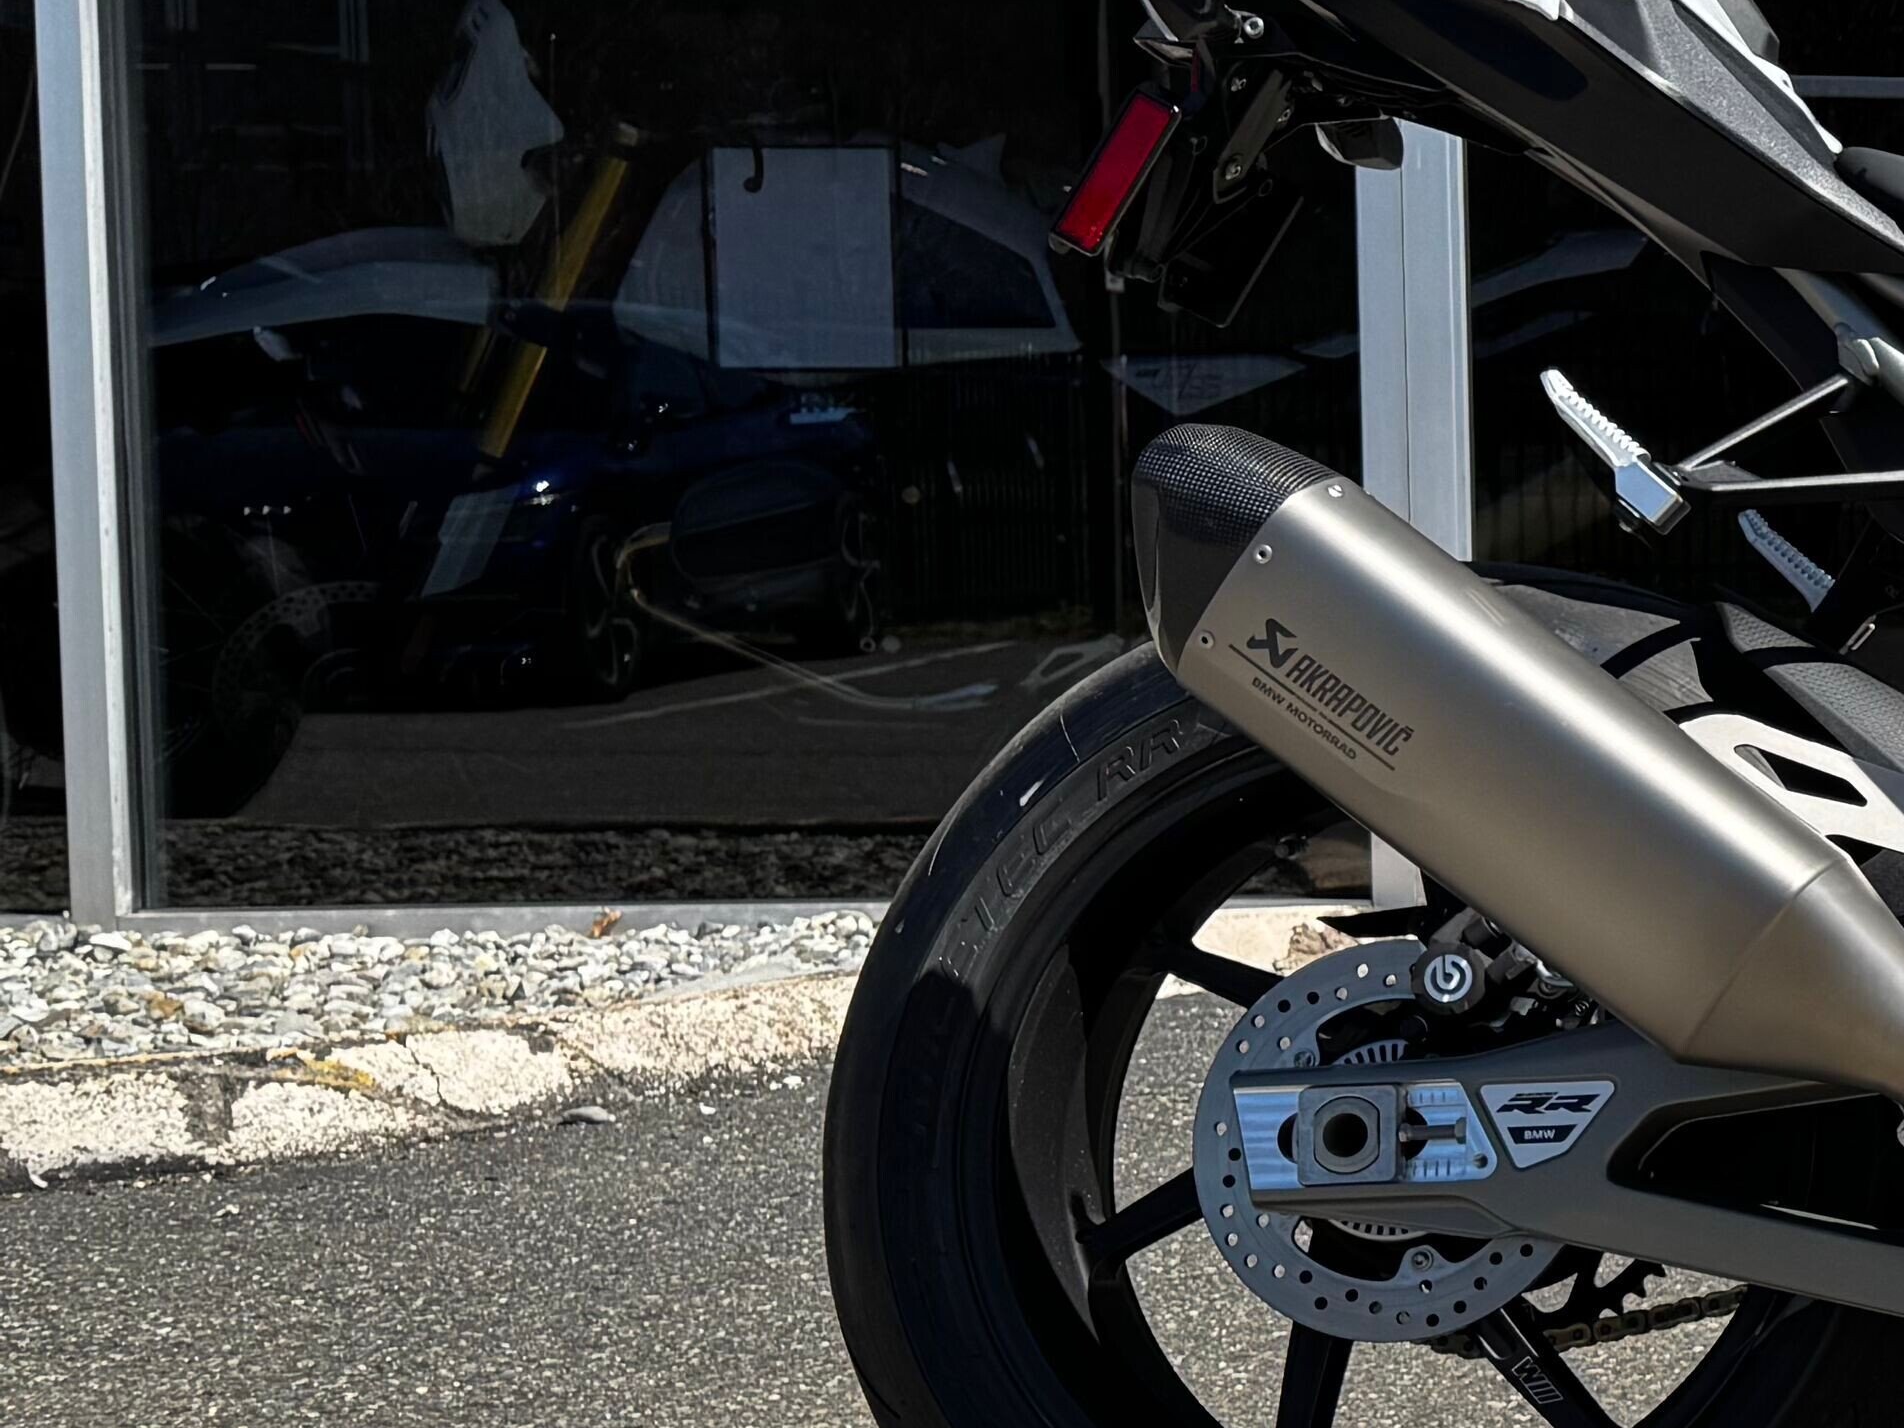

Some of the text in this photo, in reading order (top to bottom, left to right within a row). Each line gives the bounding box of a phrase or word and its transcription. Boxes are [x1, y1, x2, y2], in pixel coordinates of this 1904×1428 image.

[1251, 676, 1358, 760] BMW MOTORRAD
[1496, 1093, 1600, 1115] RR
[1523, 1128, 1556, 1141] BMW
